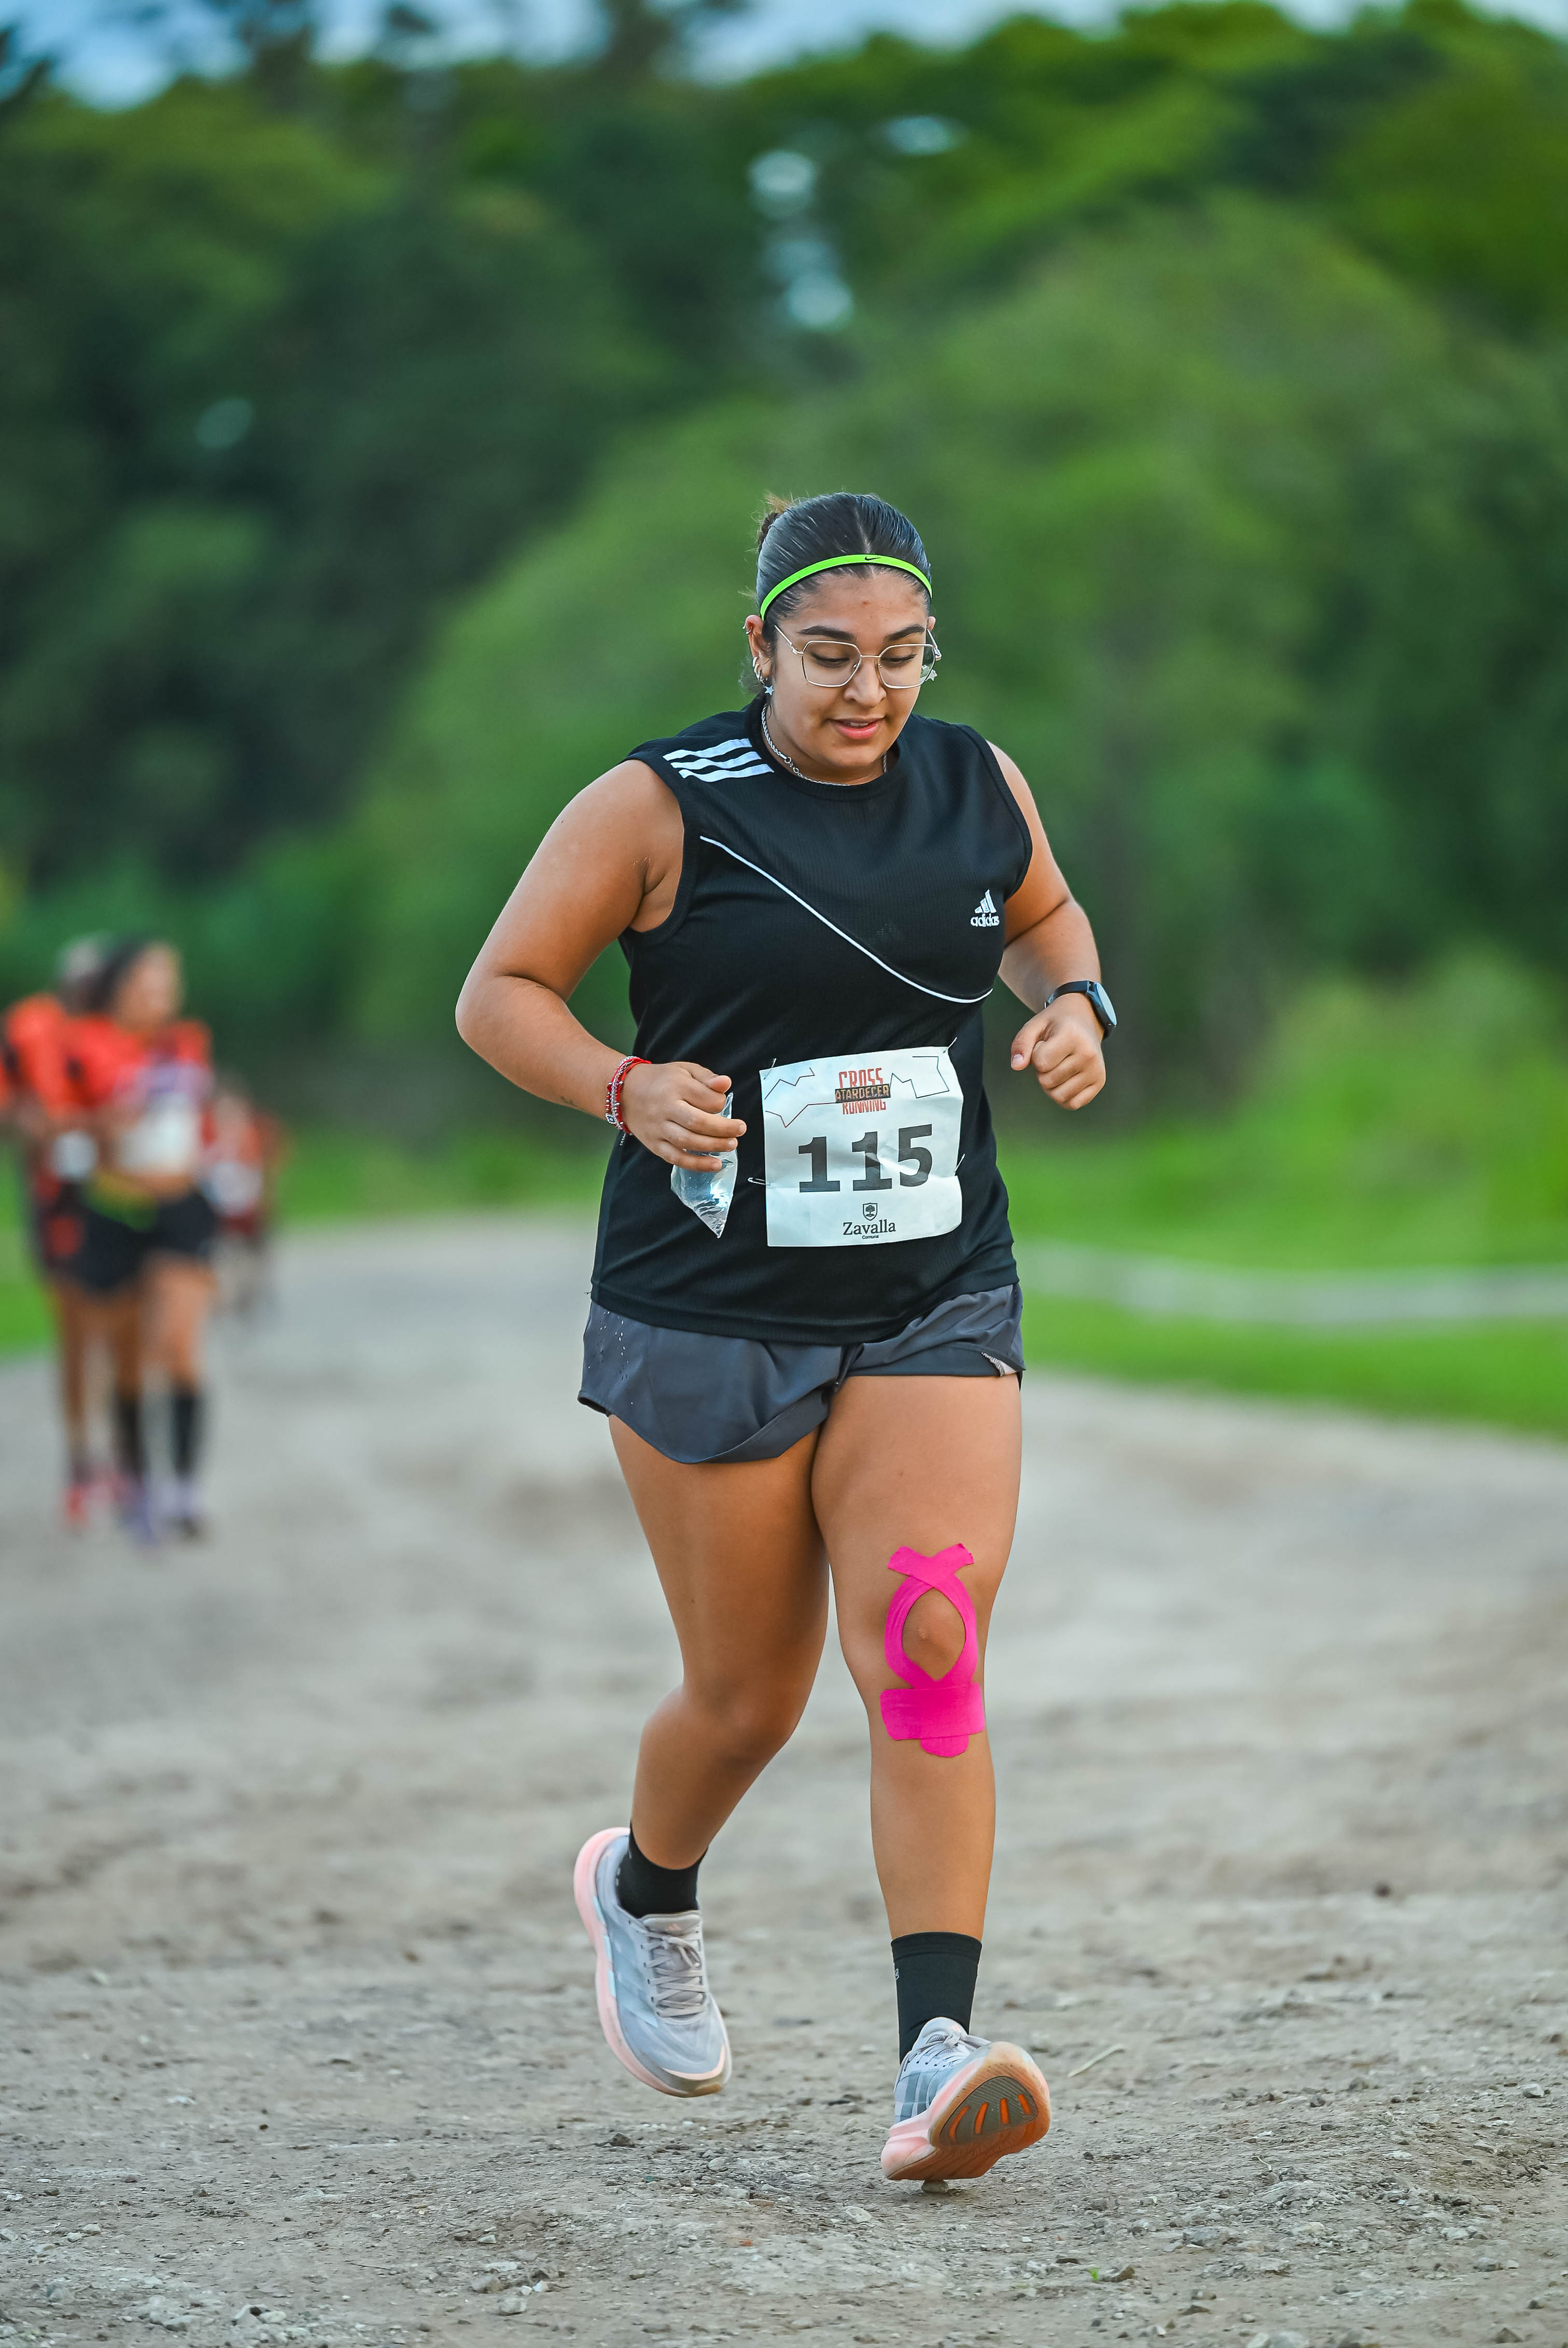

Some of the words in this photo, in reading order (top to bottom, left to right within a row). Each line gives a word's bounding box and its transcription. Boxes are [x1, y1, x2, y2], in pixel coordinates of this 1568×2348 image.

[970, 913, 1000, 927] adidas
[838, 1067, 884, 1088] CROSS
[835, 1085, 890, 1100] ATARDECER
[798, 1124, 933, 1193] 115
[843, 1219, 896, 1235] Zavalla
